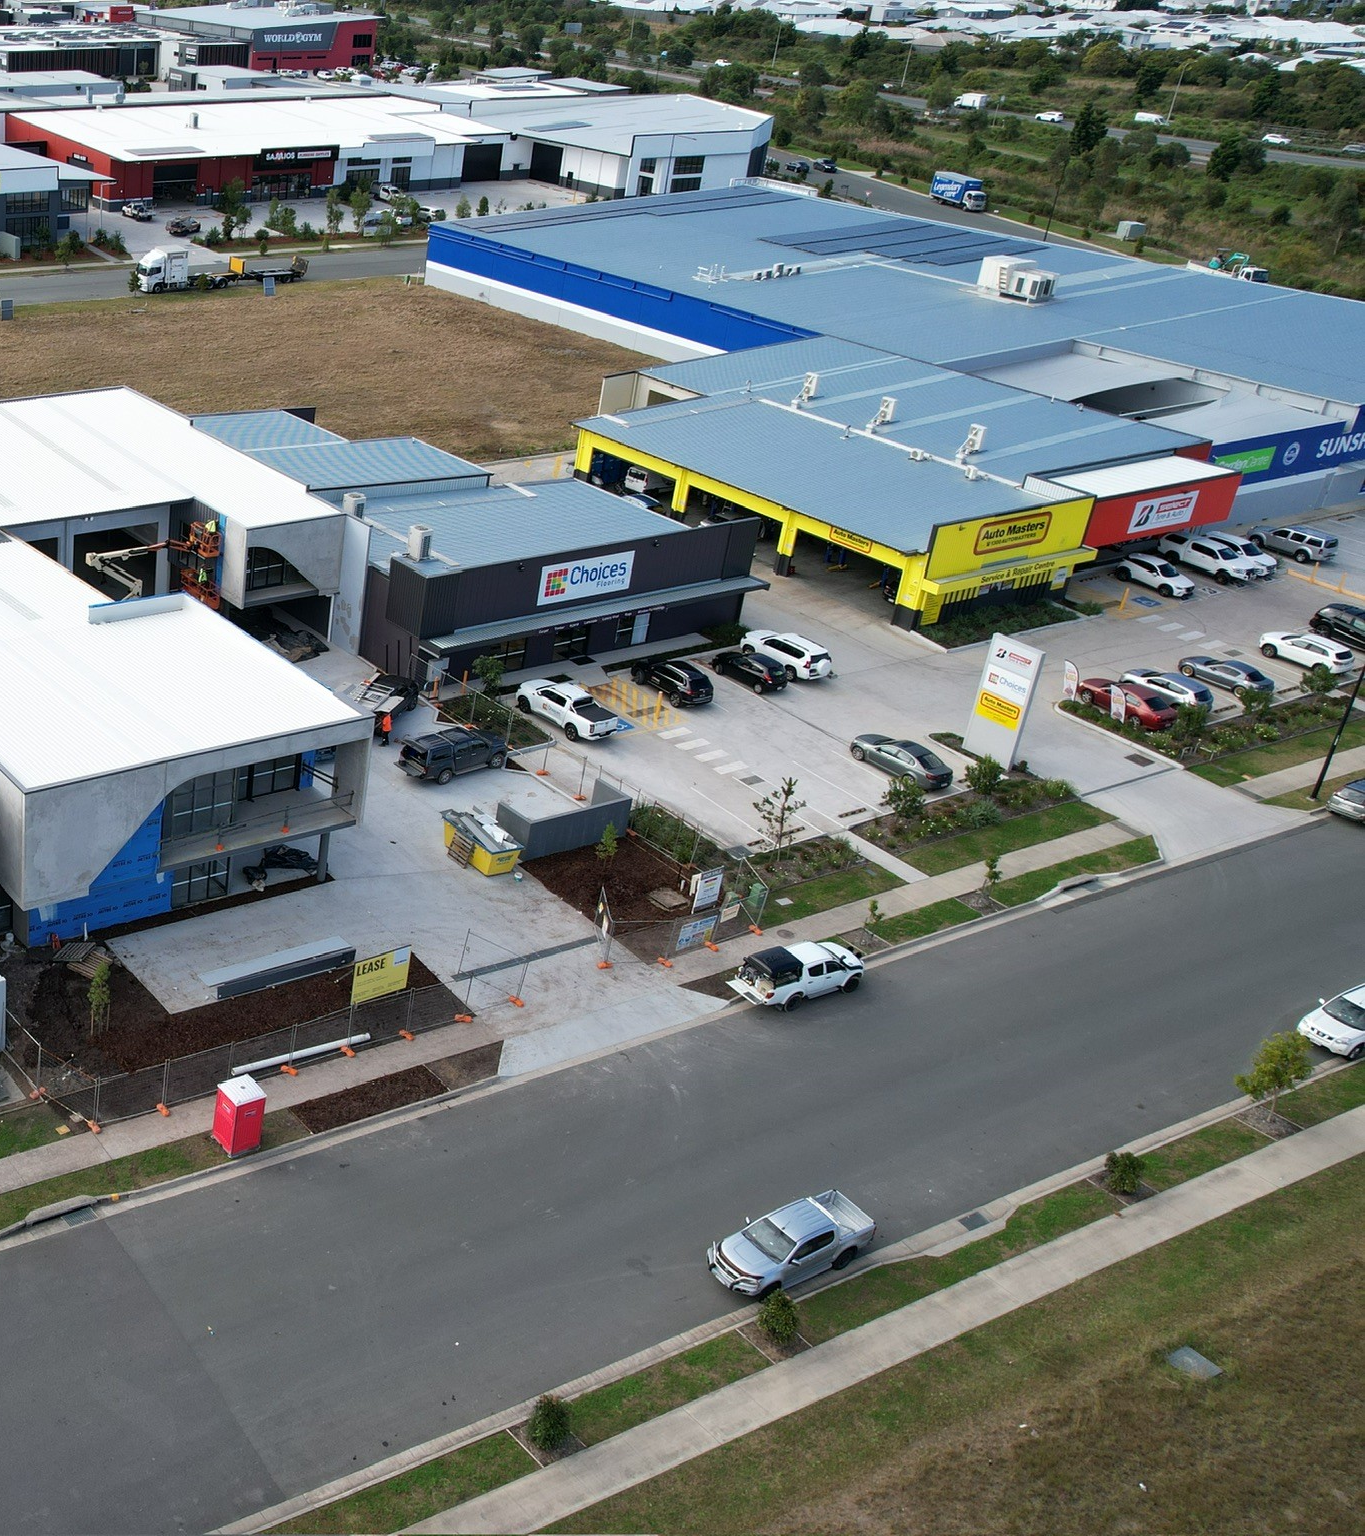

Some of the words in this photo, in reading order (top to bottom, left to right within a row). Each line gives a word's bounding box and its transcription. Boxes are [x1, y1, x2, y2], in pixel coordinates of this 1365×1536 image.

[264, 34, 295, 43] WORLD
[301, 33, 323, 42] GYM
[934, 181, 962, 194] Legendary
[982, 529, 1005, 541] Auto
[1006, 521, 1046, 536] Masters
[570, 562, 627, 586] Choices
[981, 572, 1005, 583] Service
[1005, 569, 1011, 578] &
[1012, 565, 1033, 577] Repair
[1034, 561, 1055, 570] Centre
[596, 578, 626, 588] Flooring
[999, 676, 1027, 694] Choices
[356, 957, 387, 977] LEASE
